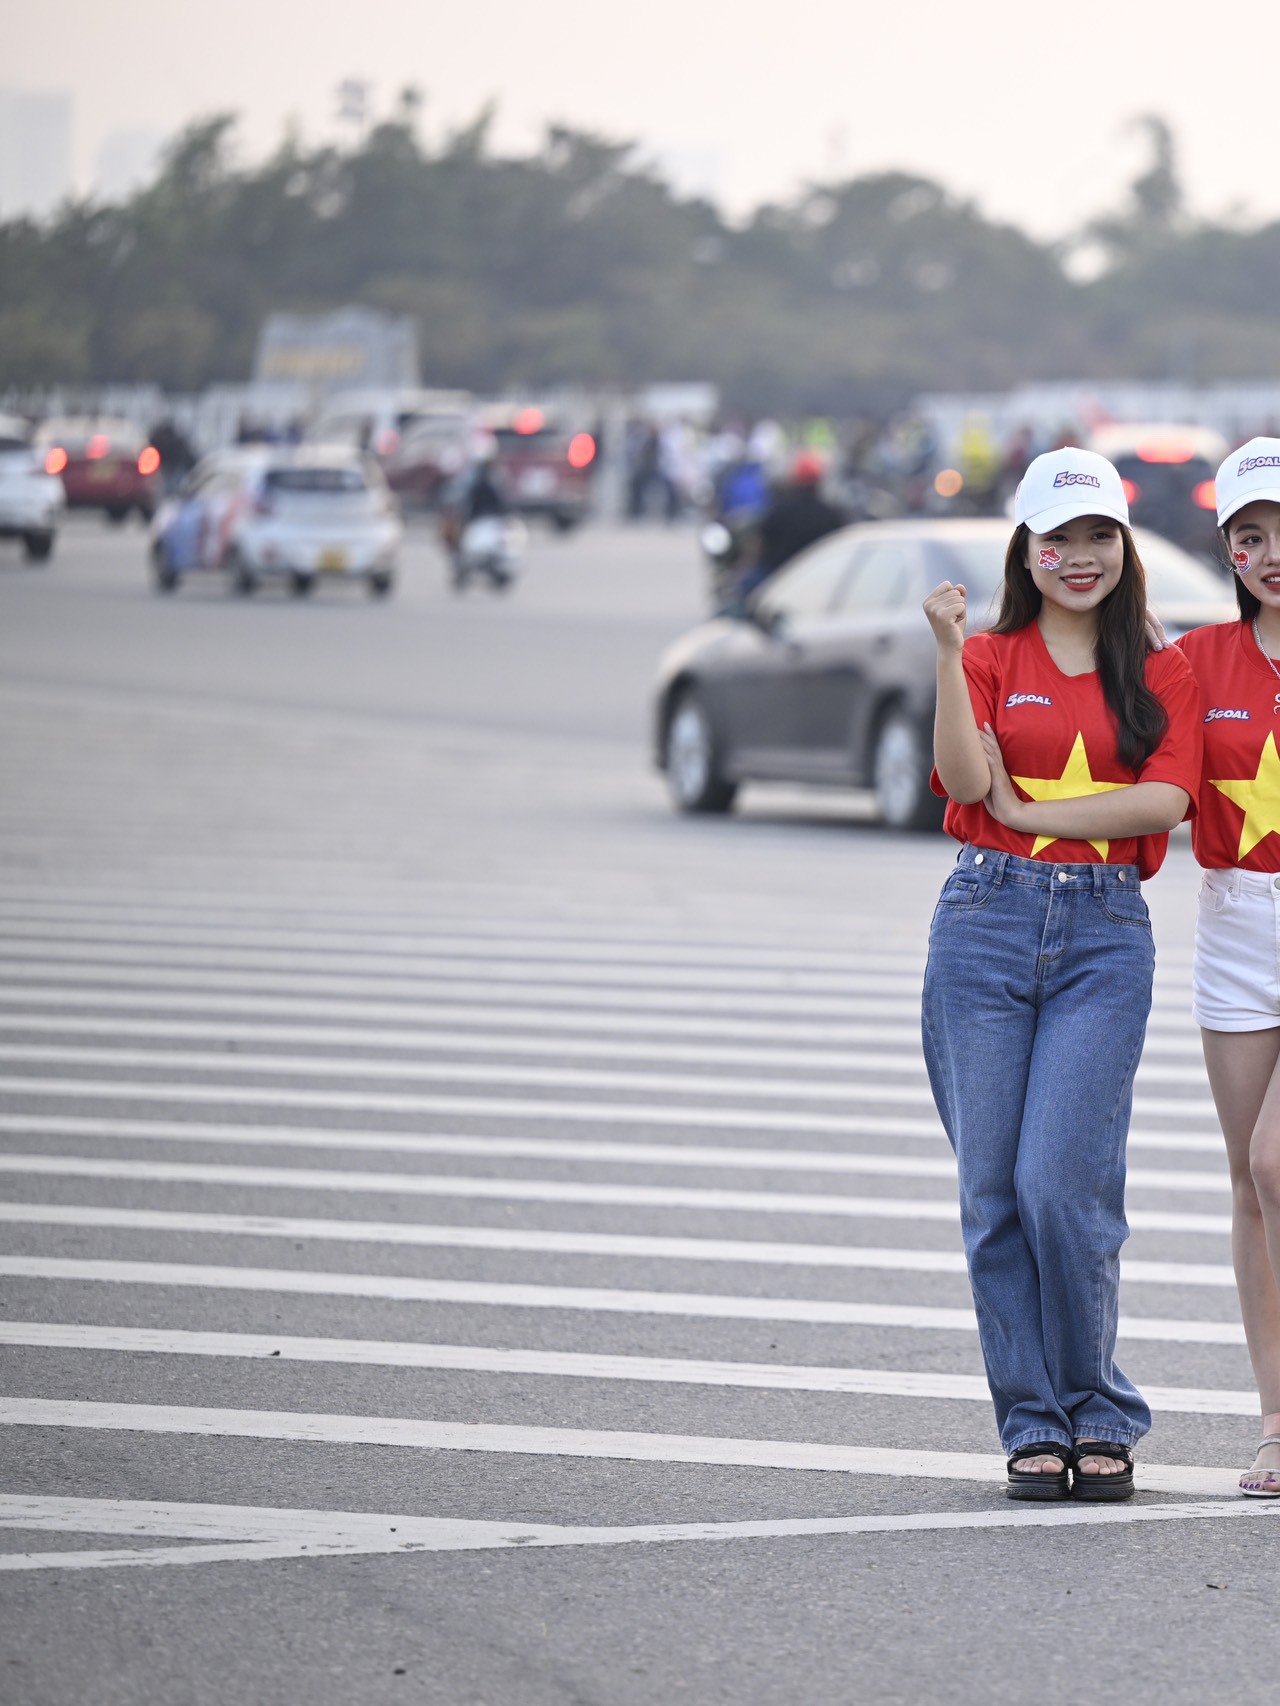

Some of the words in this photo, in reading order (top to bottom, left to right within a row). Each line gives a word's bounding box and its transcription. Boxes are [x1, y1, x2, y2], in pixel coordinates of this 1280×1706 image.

[1053, 471, 1100, 488] 5GOAL
[1005, 692, 1053, 708] 5GOAL
[1203, 707, 1250, 723] 5GOAL
